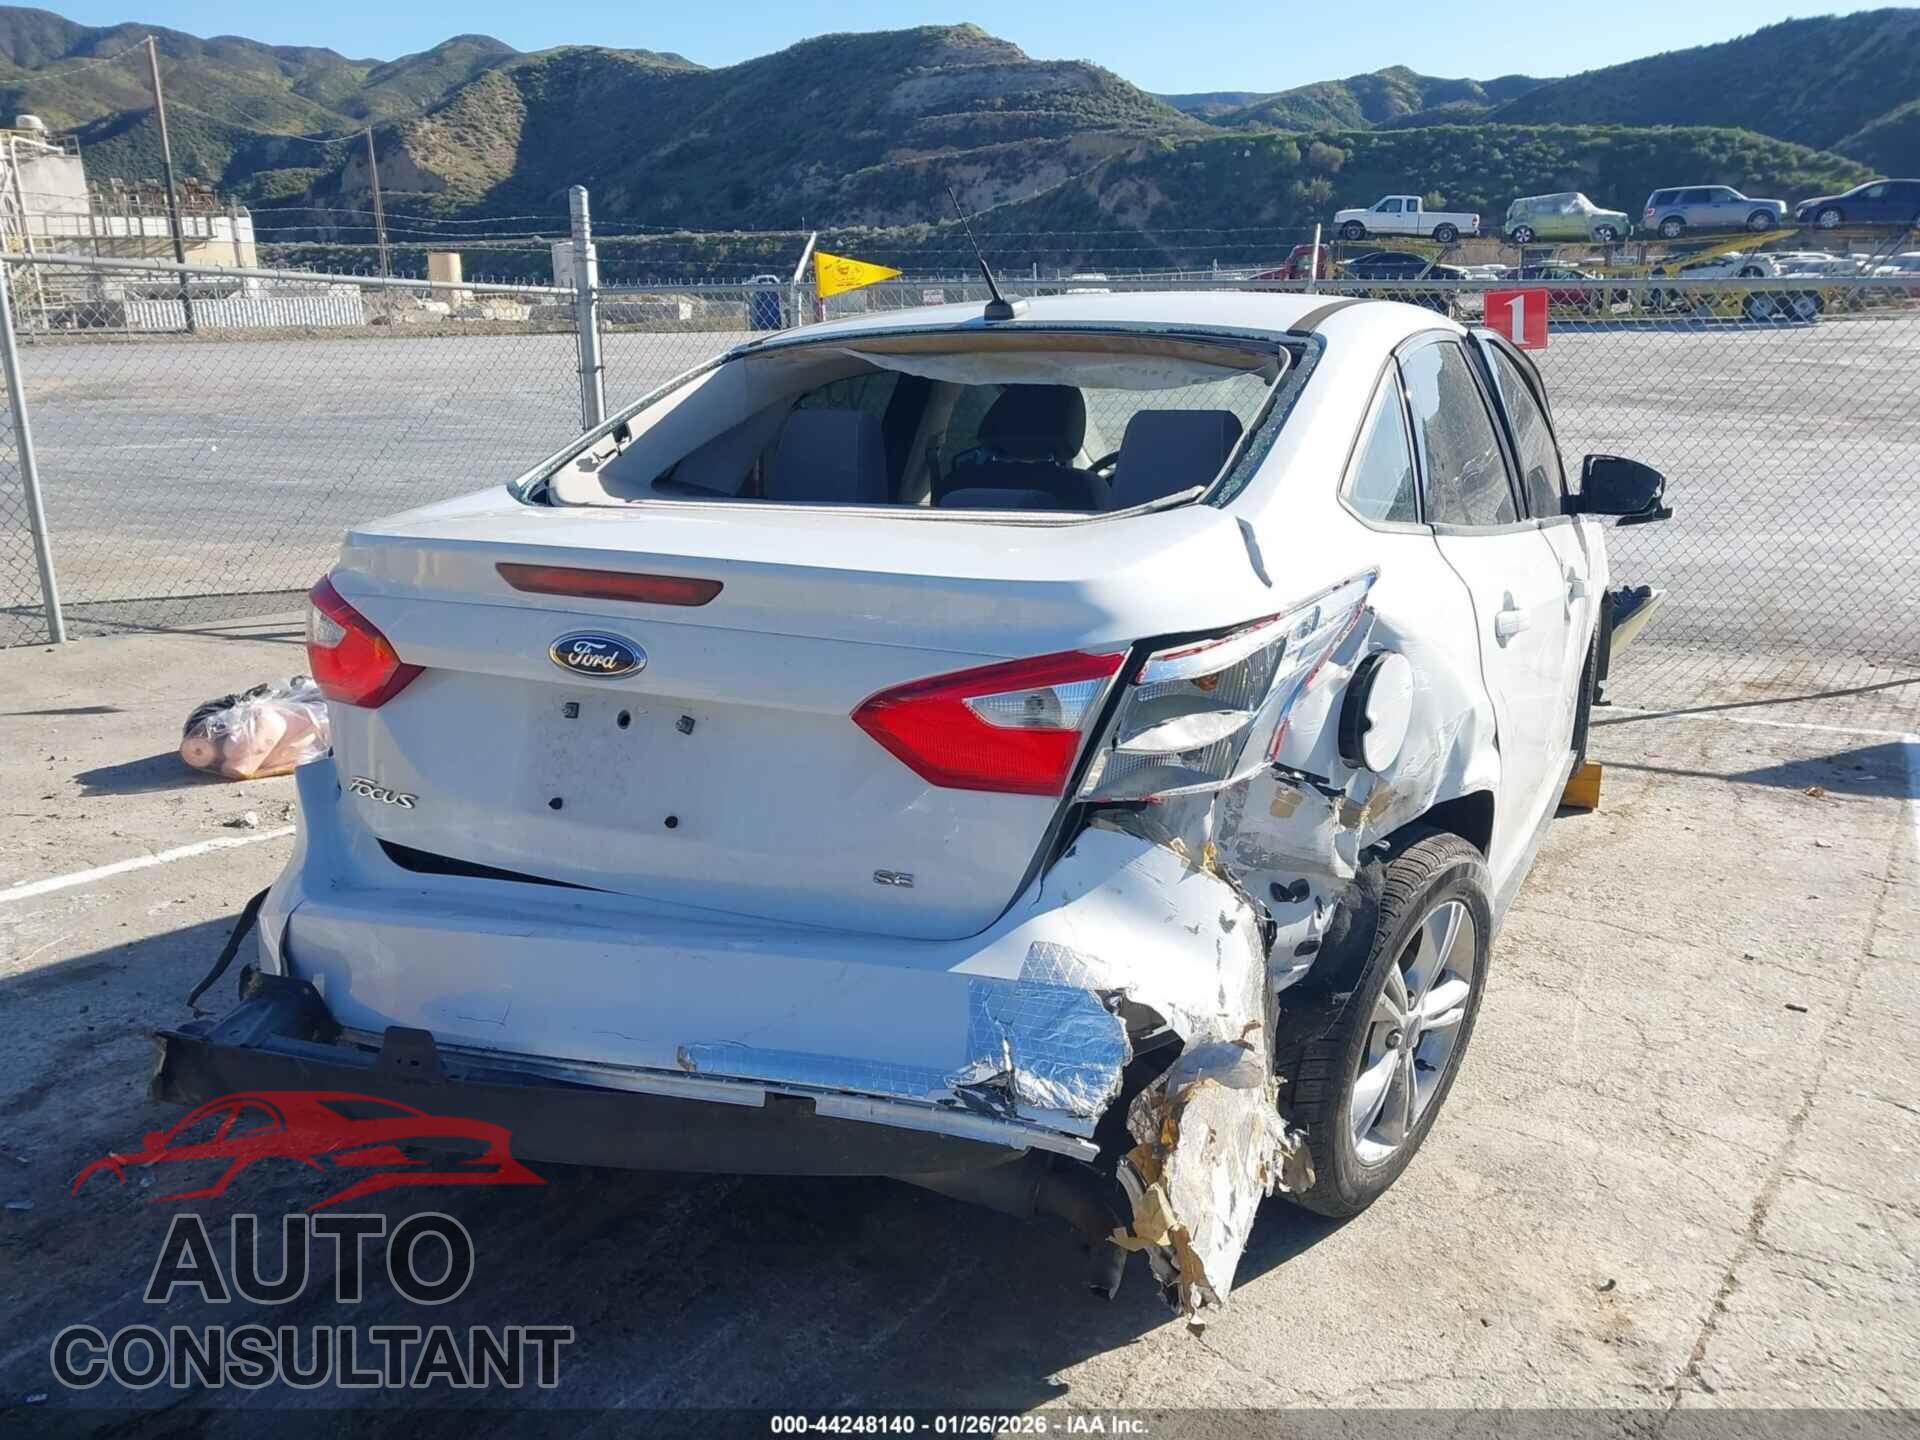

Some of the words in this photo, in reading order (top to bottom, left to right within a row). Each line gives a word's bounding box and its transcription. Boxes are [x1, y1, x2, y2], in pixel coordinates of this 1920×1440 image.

[1503, 294, 1531, 345] 1
[568, 640, 619, 669] Ford
[873, 869, 914, 888] SE
